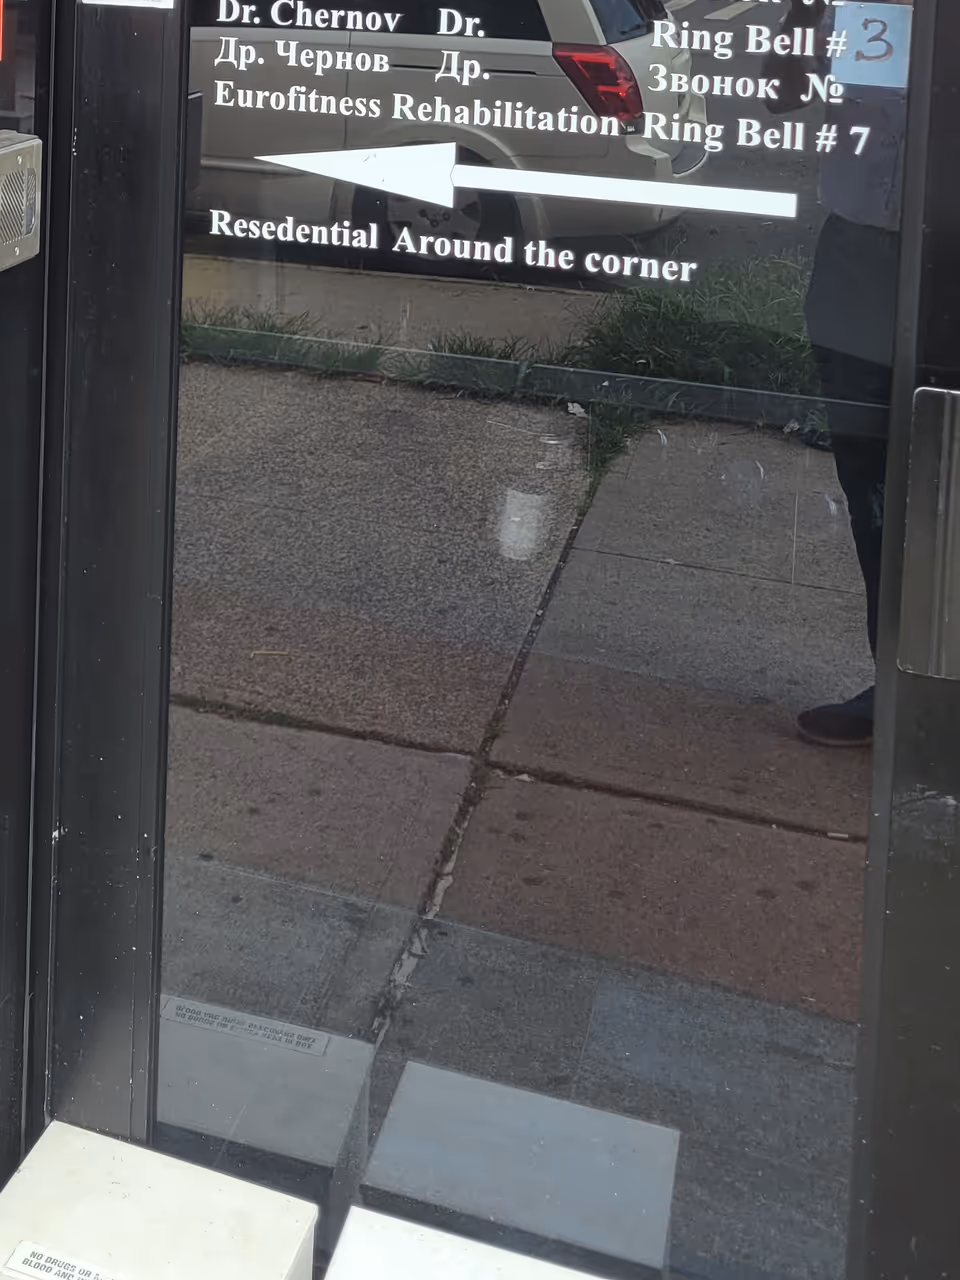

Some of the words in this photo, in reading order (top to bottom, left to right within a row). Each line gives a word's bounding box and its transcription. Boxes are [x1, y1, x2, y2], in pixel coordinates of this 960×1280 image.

[437, 8, 486, 38] Dr.
[650, 20, 733, 60] Ring
[745, 24, 815, 57] Bell
[214, 37, 265, 71] Др.
[275, 39, 391, 76] Чернов
[435, 49, 491, 84] Др.
[647, 63, 780, 100] Звонок
[214, 80, 381, 119] Eurofitness
[392, 92, 621, 138] Rehabilitation
[641, 111, 725, 152] Ring
[736, 118, 805, 151] Bell
[209, 208, 379, 250] Resedential
[392, 226, 514, 263] Around
[524, 240, 574, 270] the
[584, 251, 698, 283] corner
[22, 1257, 53, 1274] BLOOD
[29, 1251, 44, 1261] NO
[45, 1256, 77, 1272] DRUGS
[78, 1268, 92, 1278] OR
